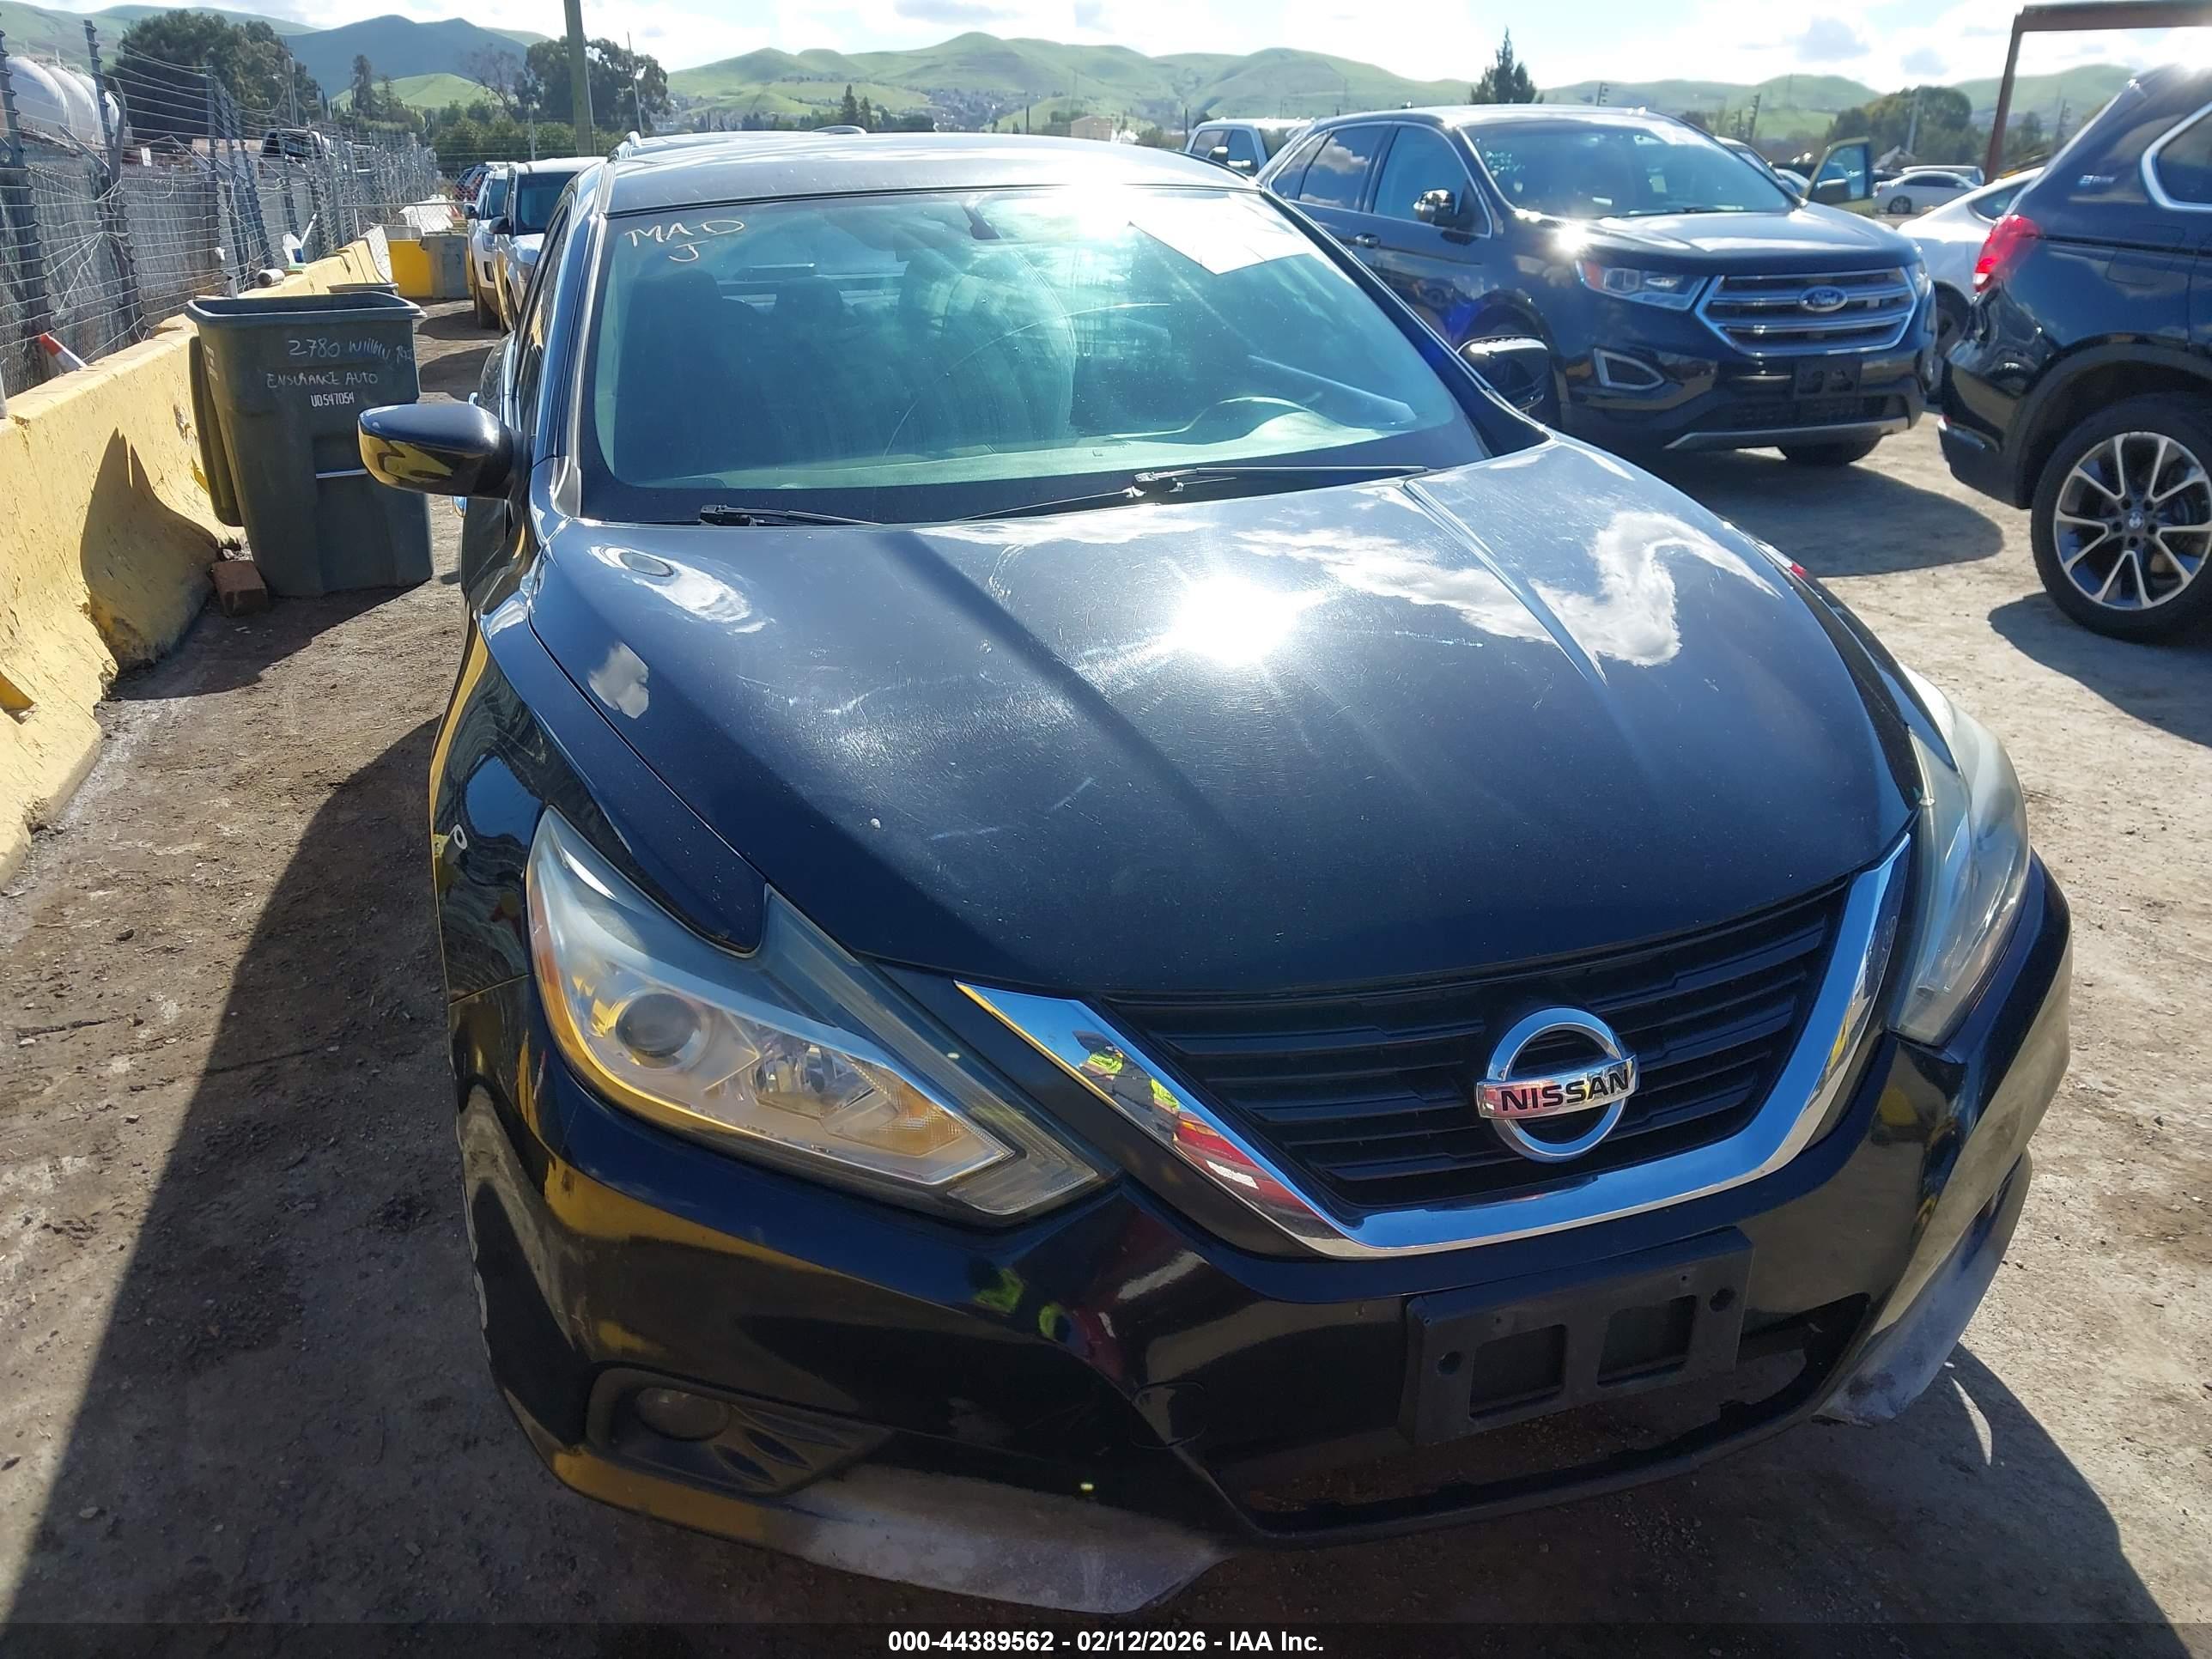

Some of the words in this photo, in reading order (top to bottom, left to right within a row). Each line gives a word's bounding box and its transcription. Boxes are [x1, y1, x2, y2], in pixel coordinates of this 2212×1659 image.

[288, 337, 341, 358] 2780
[344, 371, 378, 386] AUTO
[1500, 1068, 1630, 1112] NISSAN
